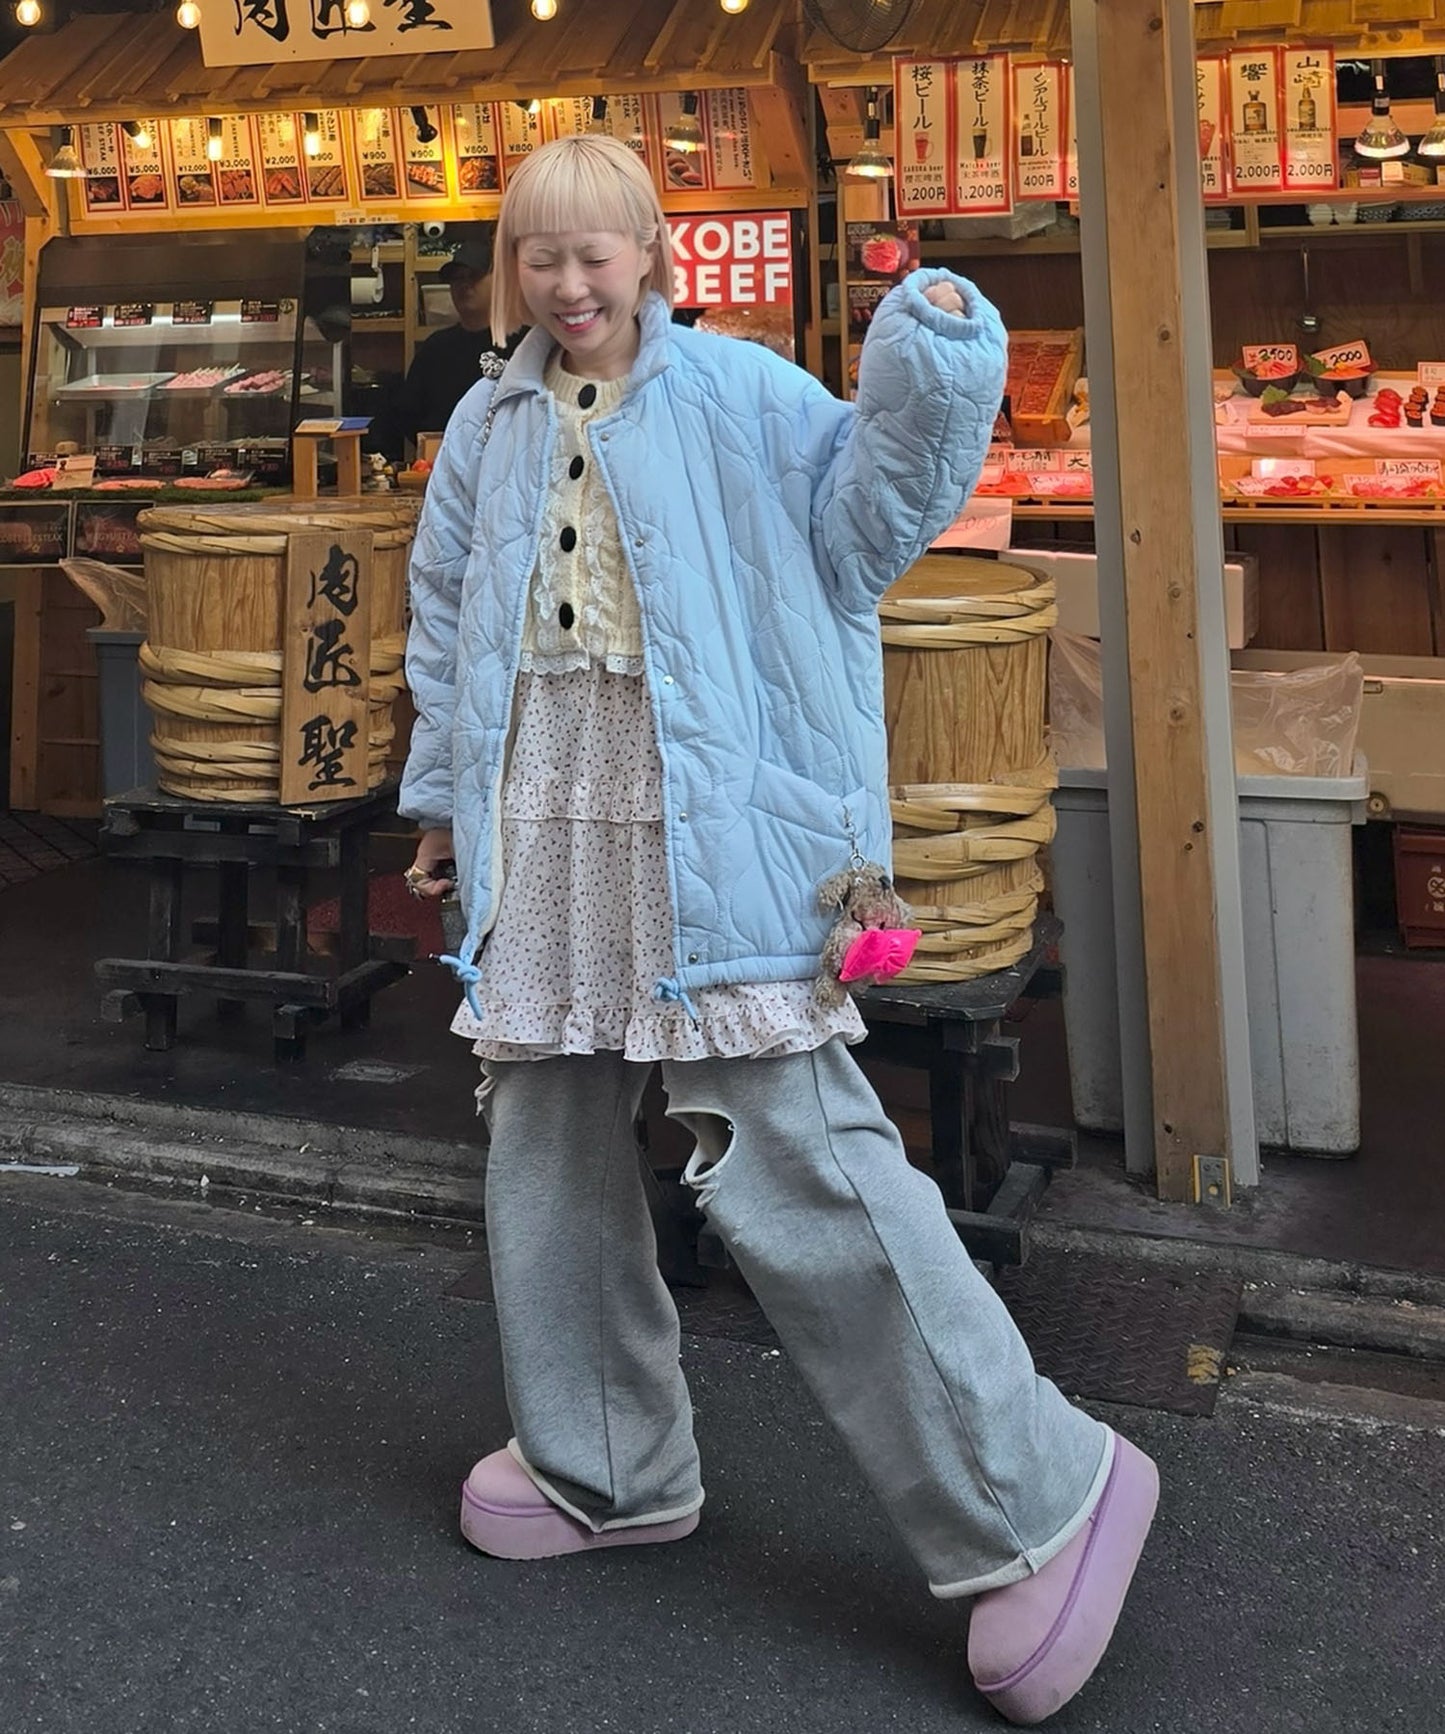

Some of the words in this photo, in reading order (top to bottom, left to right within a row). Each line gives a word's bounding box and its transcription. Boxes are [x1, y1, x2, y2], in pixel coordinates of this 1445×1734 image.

[1240, 62, 1269, 81] 響
[911, 65, 933, 130] 桜ビール
[971, 61, 990, 128] 抹茶ビール
[411, 150, 434, 158] ¥900
[464, 145, 489, 154] ¥800
[508, 143, 533, 152] ¥800
[264, 155, 296, 165] ¥2,000
[362, 151, 387, 160] ¥900
[129, 164, 160, 174] ¥5,000
[1024, 173, 1054, 187] 400円
[668, 219, 789, 260] KOBE
[673, 263, 790, 304] BEEF
[297, 543, 363, 792] 肉匠聖
